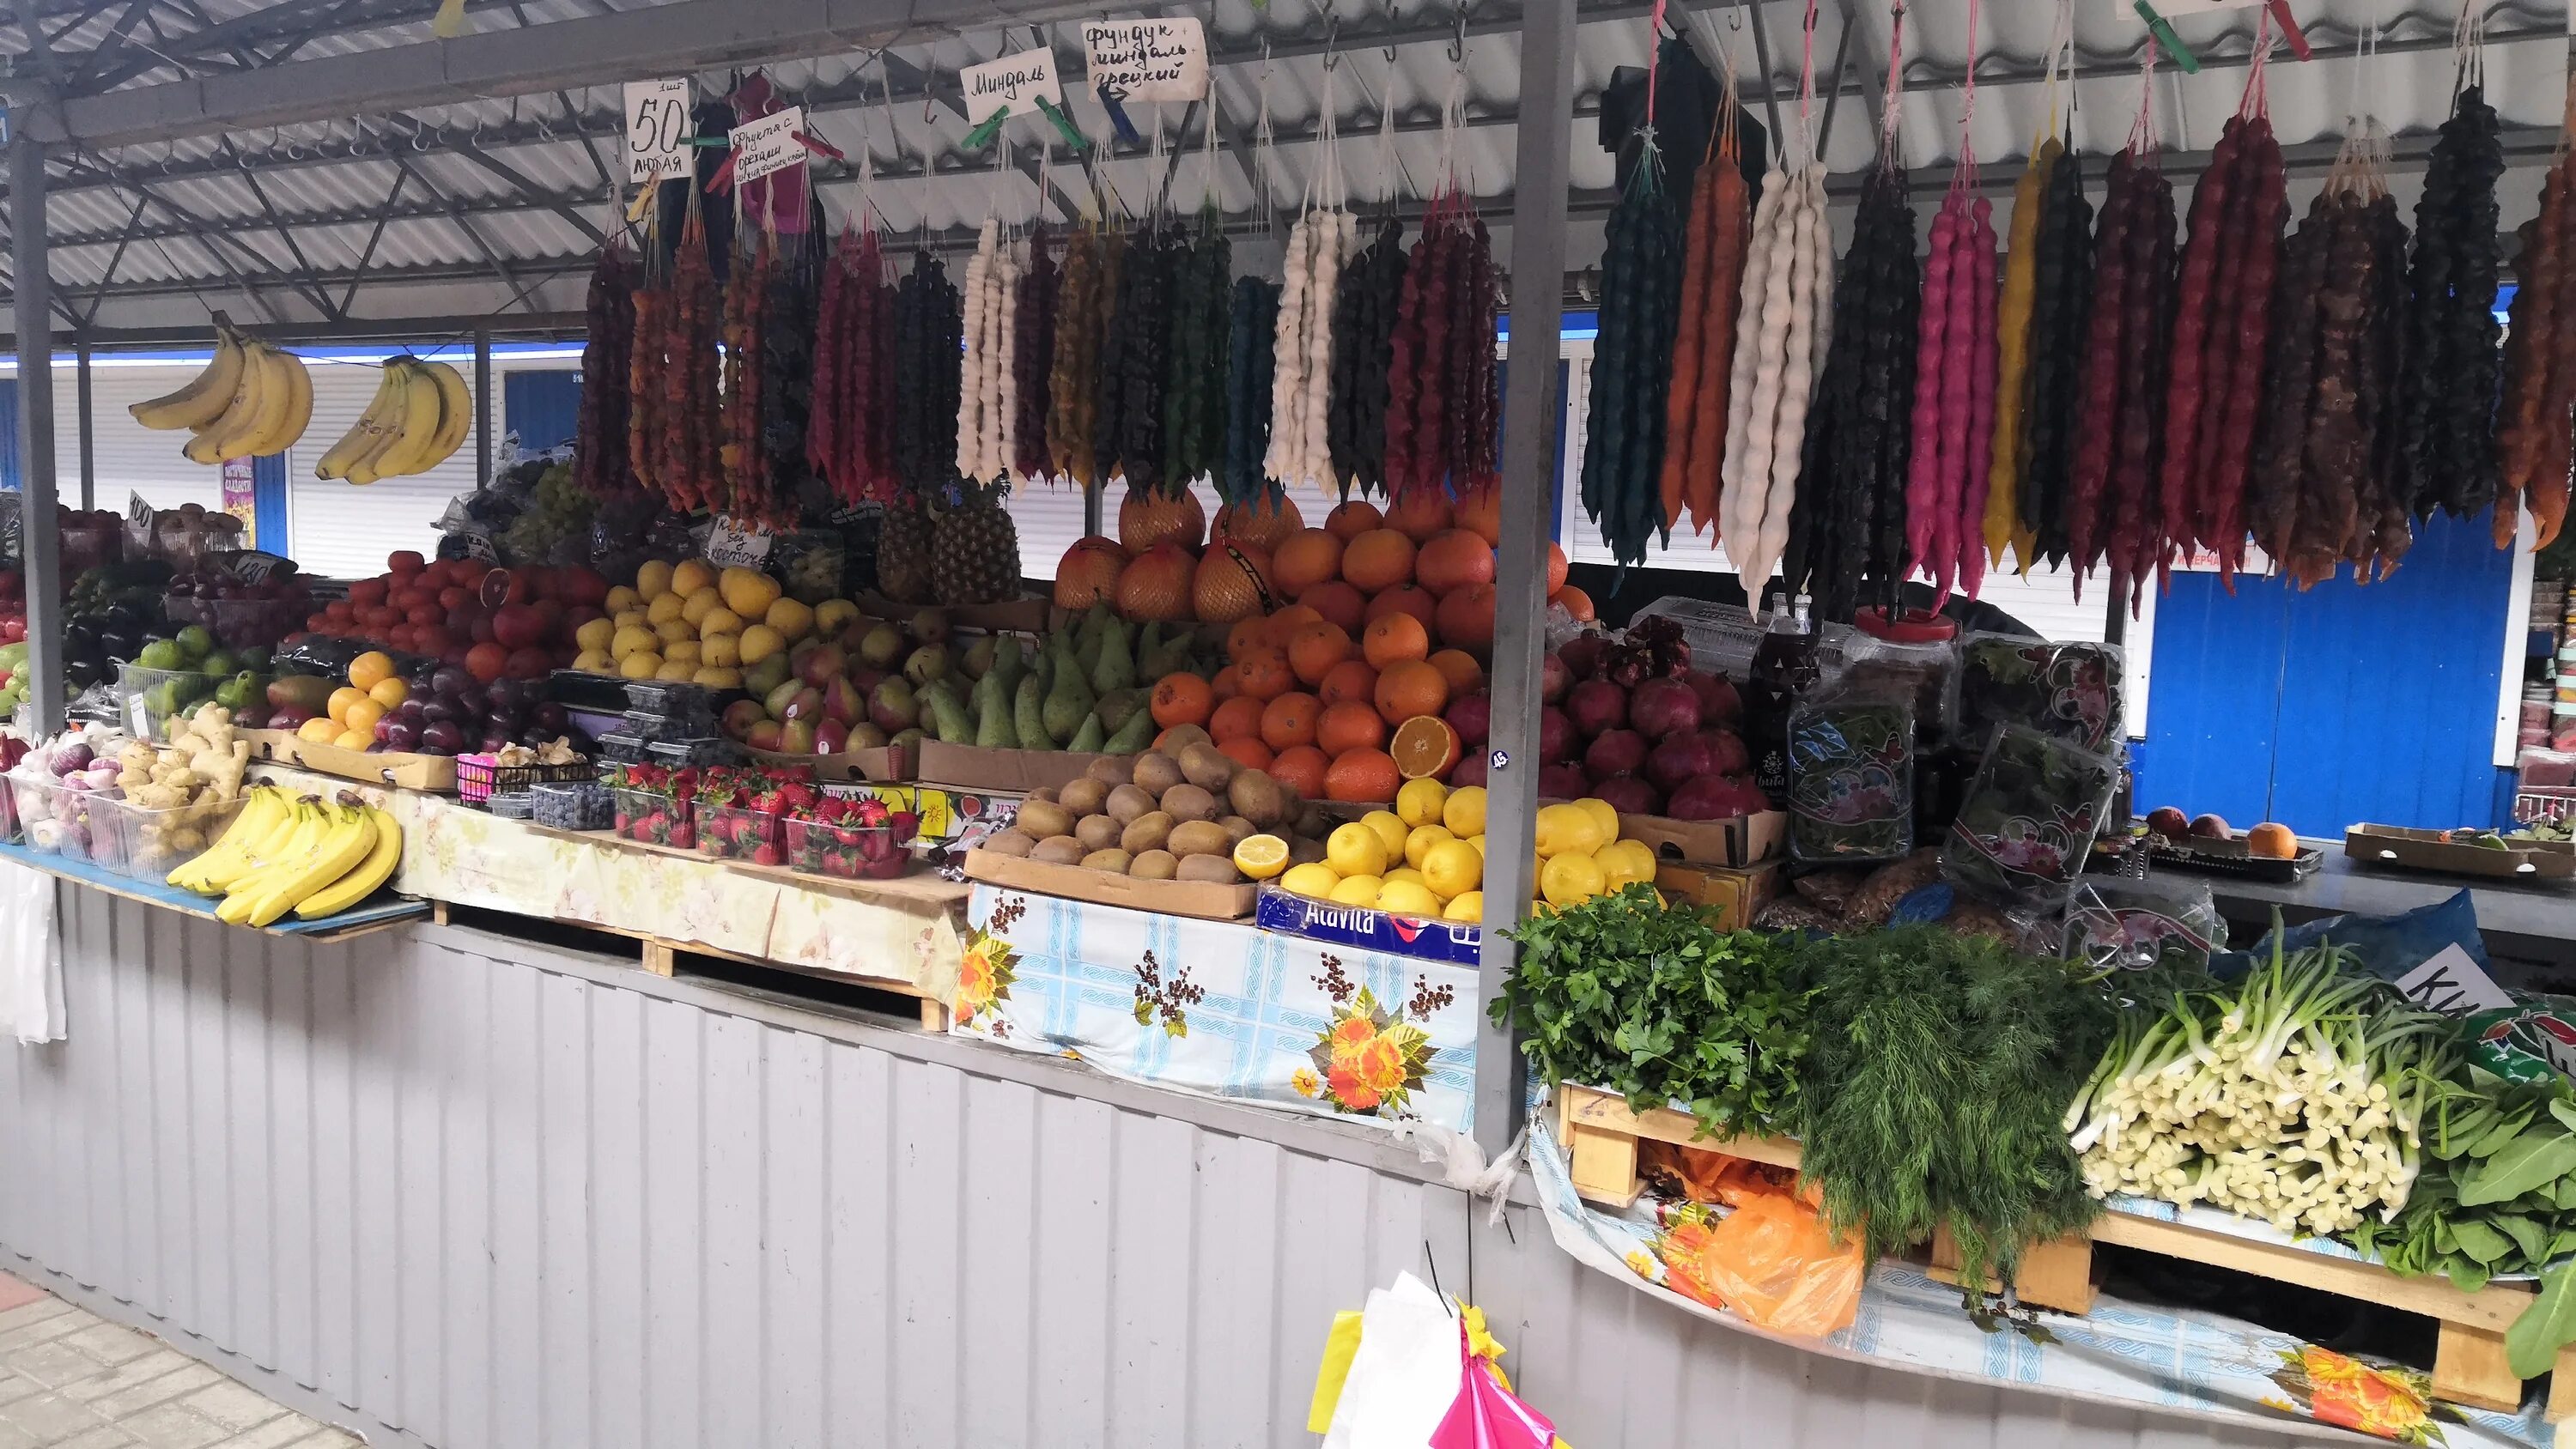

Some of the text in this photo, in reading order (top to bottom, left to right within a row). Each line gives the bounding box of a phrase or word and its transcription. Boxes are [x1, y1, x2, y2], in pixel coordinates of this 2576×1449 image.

[1086, 24, 1174, 50] фундук
[1092, 44, 1187, 70] миндаль
[971, 65, 1045, 100] Миндаль
[1094, 62, 1184, 88] грецкий
[631, 98, 684, 153] 50
[131, 496, 150, 528] 100
[1493, 751, 1509, 768] 45
